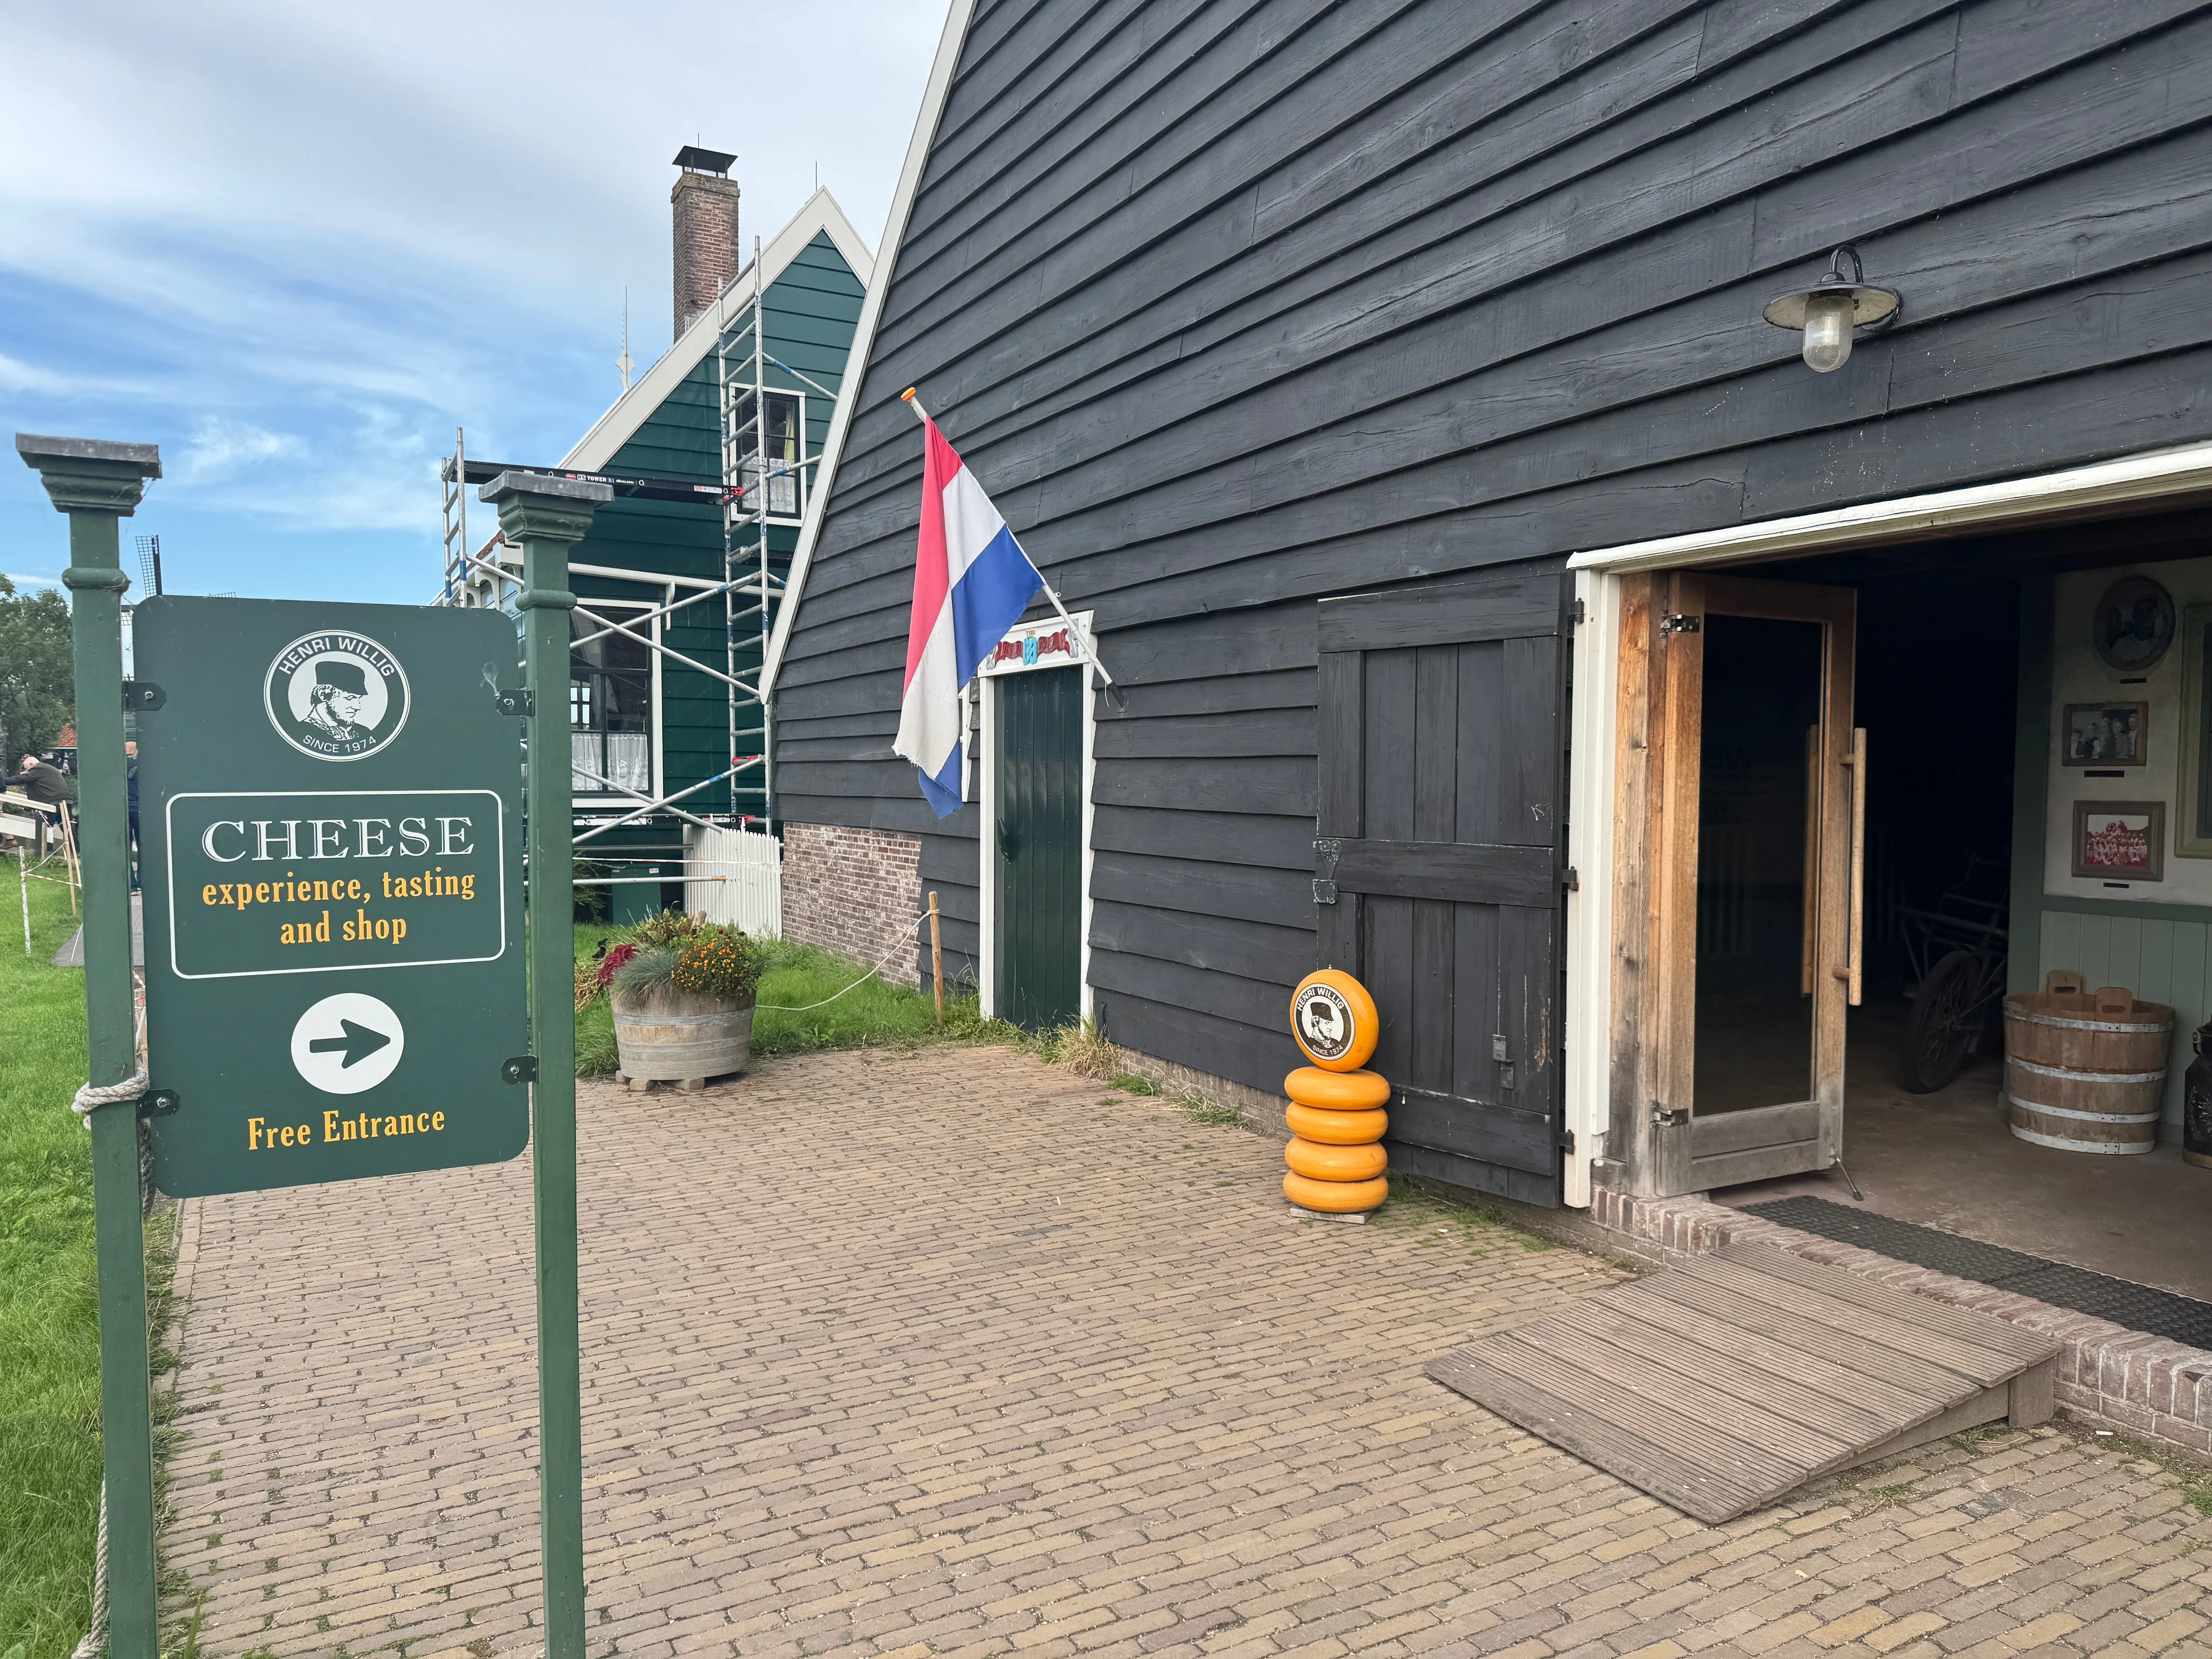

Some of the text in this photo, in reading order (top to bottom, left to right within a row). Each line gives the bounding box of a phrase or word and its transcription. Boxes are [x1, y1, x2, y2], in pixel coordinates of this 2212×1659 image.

[279, 637, 395, 676] HENRI WILLIG
[303, 735, 376, 753] SINCE 1974
[202, 817, 474, 863] CHEESE
[203, 867, 475, 910] experience, tasting
[281, 908, 407, 945] and shop
[1297, 988, 1345, 1011] HENRI WILLIG
[1312, 1045, 1343, 1055] SINCE 1974
[248, 1110, 445, 1150] Free Entrance
